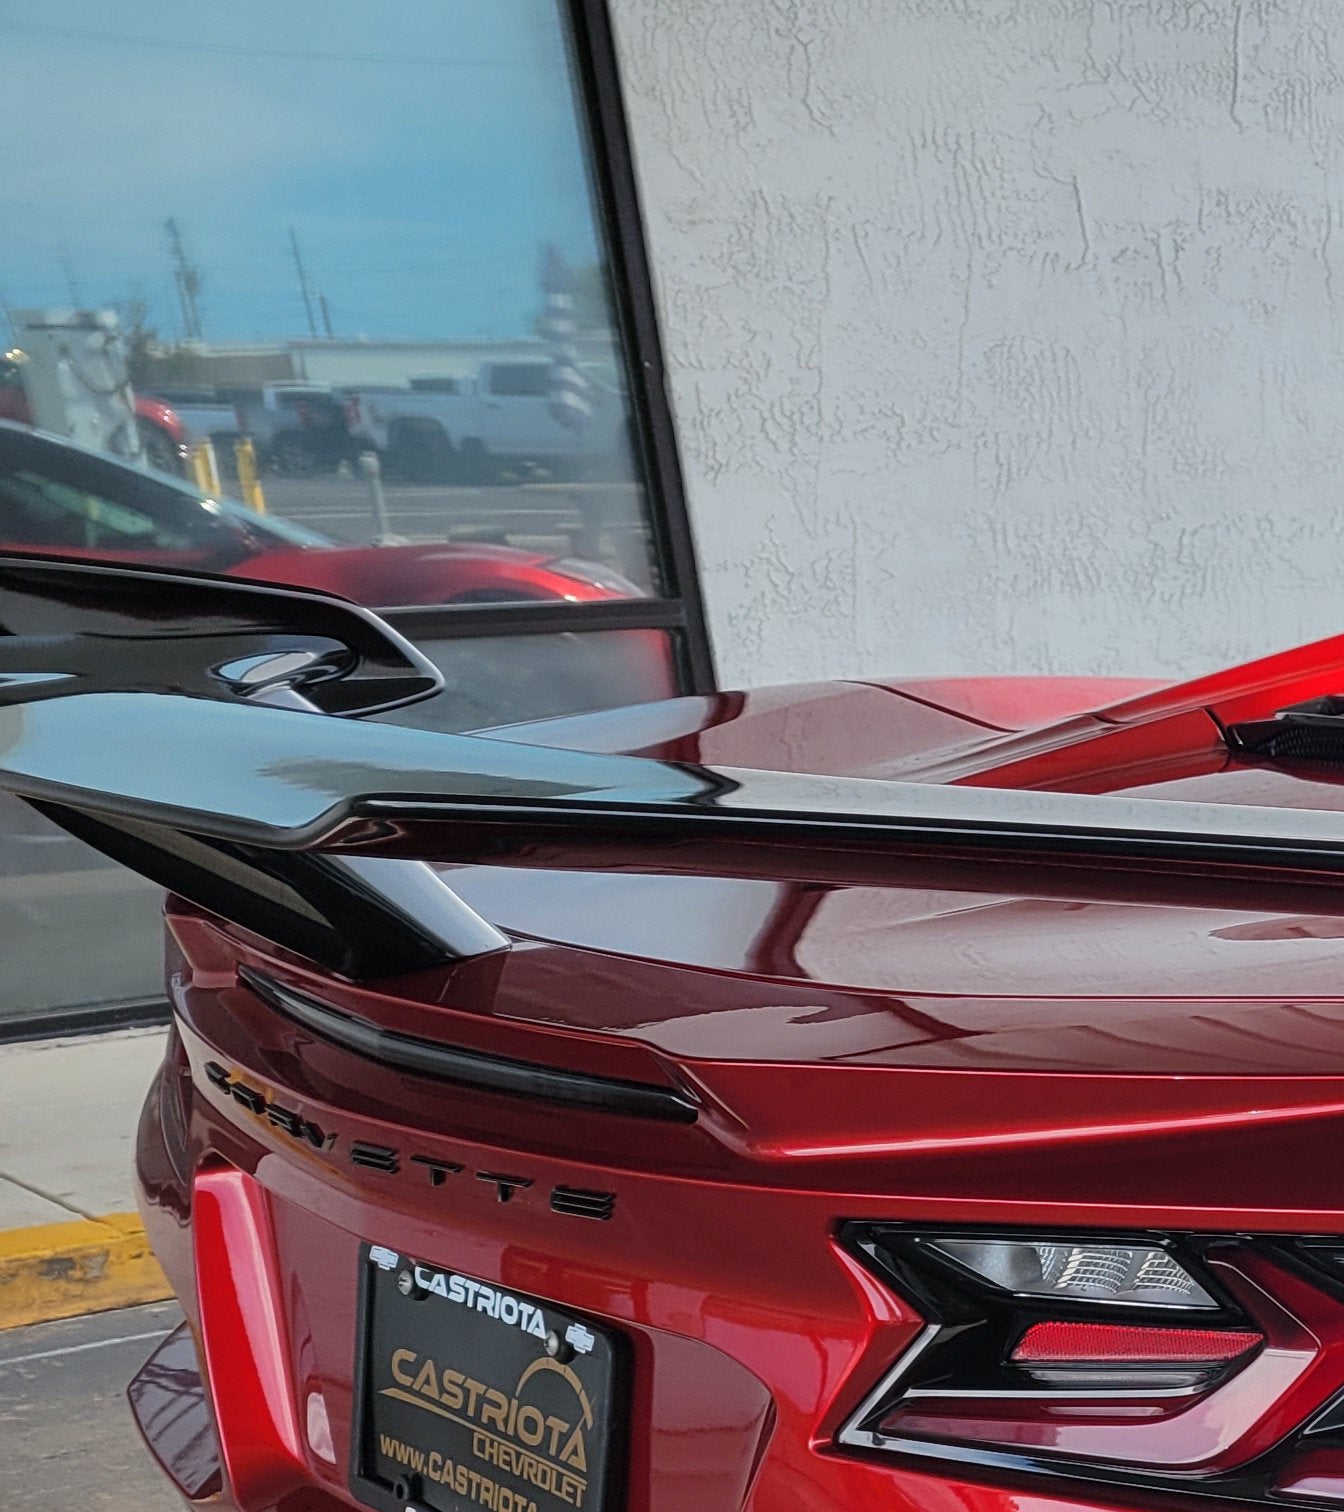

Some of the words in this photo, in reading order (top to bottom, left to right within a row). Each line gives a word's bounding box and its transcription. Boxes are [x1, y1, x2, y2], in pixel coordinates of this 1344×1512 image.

[204, 1060, 616, 1220] CORVETTE
[414, 1267, 546, 1339] CASTRIOTA
[391, 1349, 587, 1471] CASTRIOTA
[473, 1432, 587, 1507] CHEVROLET
